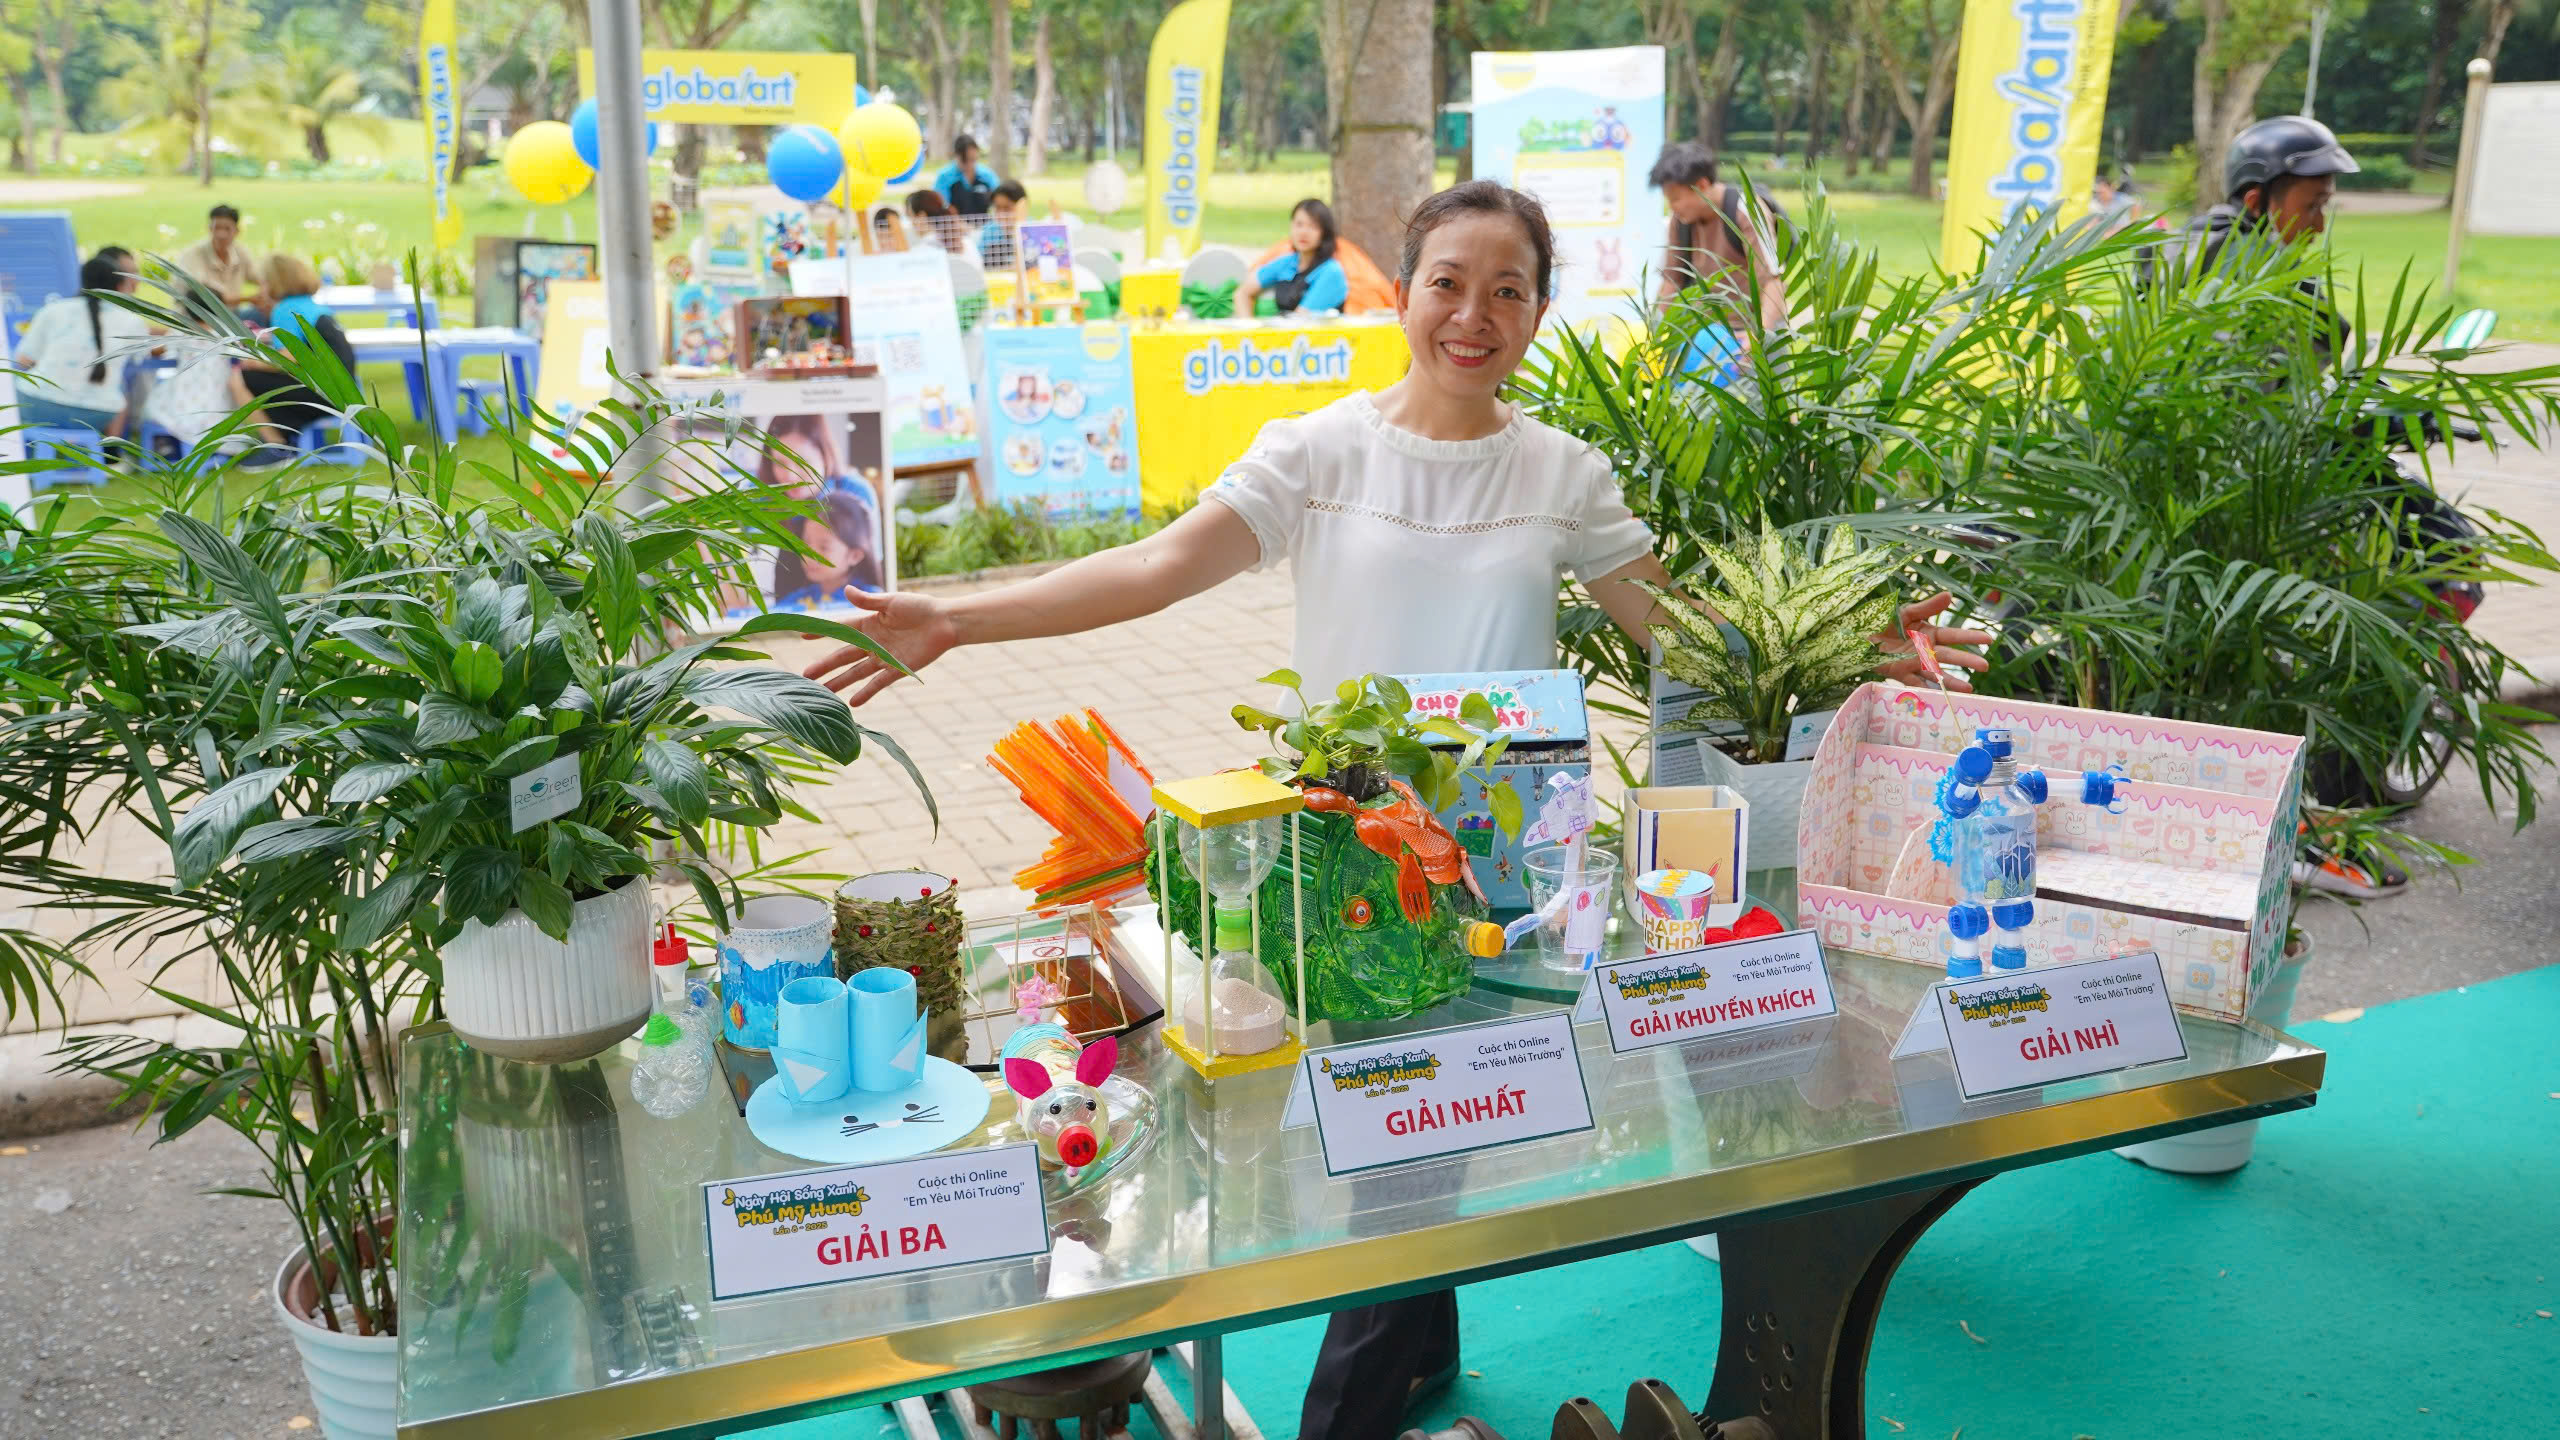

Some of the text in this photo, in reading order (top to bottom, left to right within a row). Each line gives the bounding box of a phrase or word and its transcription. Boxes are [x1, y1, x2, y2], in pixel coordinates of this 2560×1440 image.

[1415, 694, 1459, 712] CHO
[1645, 914, 1703, 936] HAPPY
[1740, 951, 1801, 968] Cuộc thi Online
[1617, 963, 1700, 987] Ngày Hội Sống Xanh
[1751, 968, 1765, 979] Yêu
[1767, 966, 1782, 977] Môi
[2081, 972, 2142, 990] Cuộc thi Online
[1621, 984, 1647, 1000] Phú
[1649, 981, 1668, 997] Mỹ
[1959, 983, 2040, 1007] Ngày Hội Sống Xanh
[2092, 991, 2106, 1003] Yêu
[2107, 988, 2125, 999] Môi
[1630, 987, 1816, 1037] GIẢI KHUYẾN KHÍCH
[1962, 1007, 1989, 1022] Phú
[1990, 1003, 2009, 1019] Mỹ
[1478, 1036, 1550, 1056] Cuộc thi Online
[2019, 1019, 2119, 1062] GIẢI NHÌ
[1331, 1049, 1430, 1076] Ngày Hội Sống Xanh
[1491, 1056, 1507, 1068] Yêu
[1509, 1053, 1527, 1065] Môi
[1334, 1075, 1365, 1092] Phú
[1367, 1071, 1390, 1088] Mỹ
[1385, 1083, 1527, 1136] GIẢI NHẤT
[918, 1168, 1008, 1190] Cuộc thi Online
[735, 1181, 857, 1210] Ngày Hội Sống Xanh
[930, 1190, 951, 1205] Yêu
[954, 1187, 977, 1202] Môi
[737, 1208, 775, 1228] Phú
[778, 1204, 806, 1224] Mỹ
[816, 1223, 947, 1266] GIẢI BA
